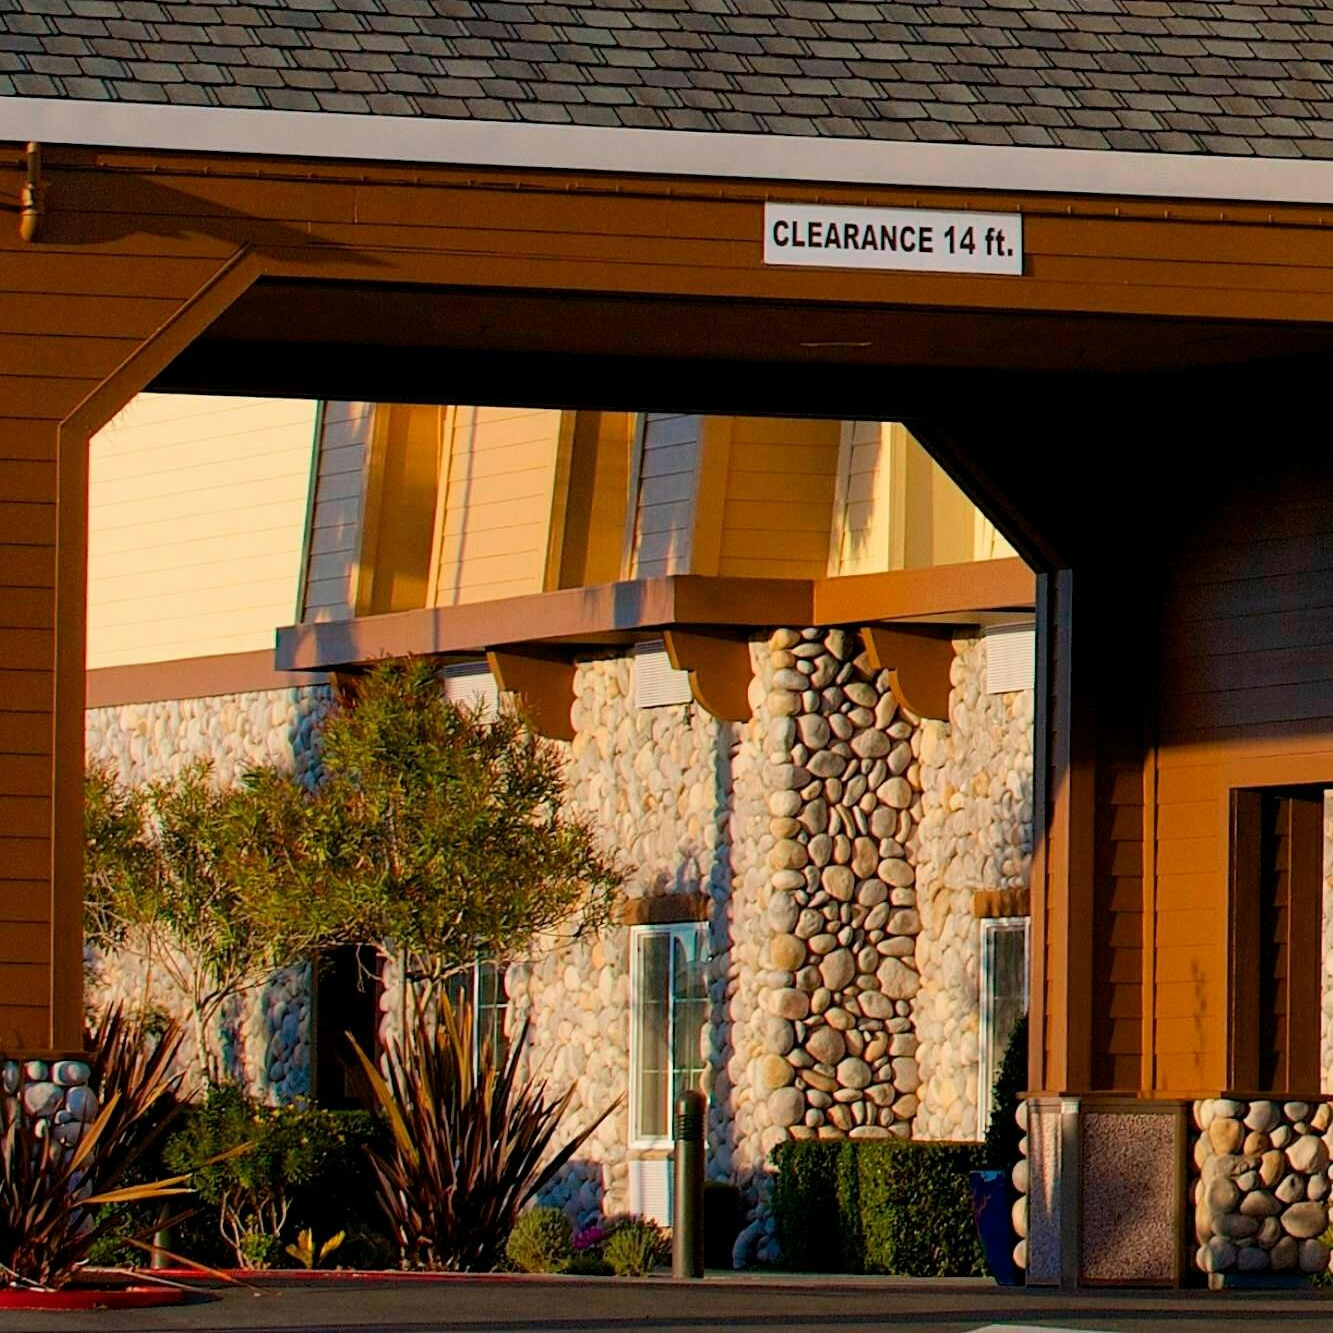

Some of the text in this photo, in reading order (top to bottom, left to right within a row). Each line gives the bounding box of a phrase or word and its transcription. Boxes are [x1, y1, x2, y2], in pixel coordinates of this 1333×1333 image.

[772, 220, 1014, 256] CLEARANCE 14 ft.
